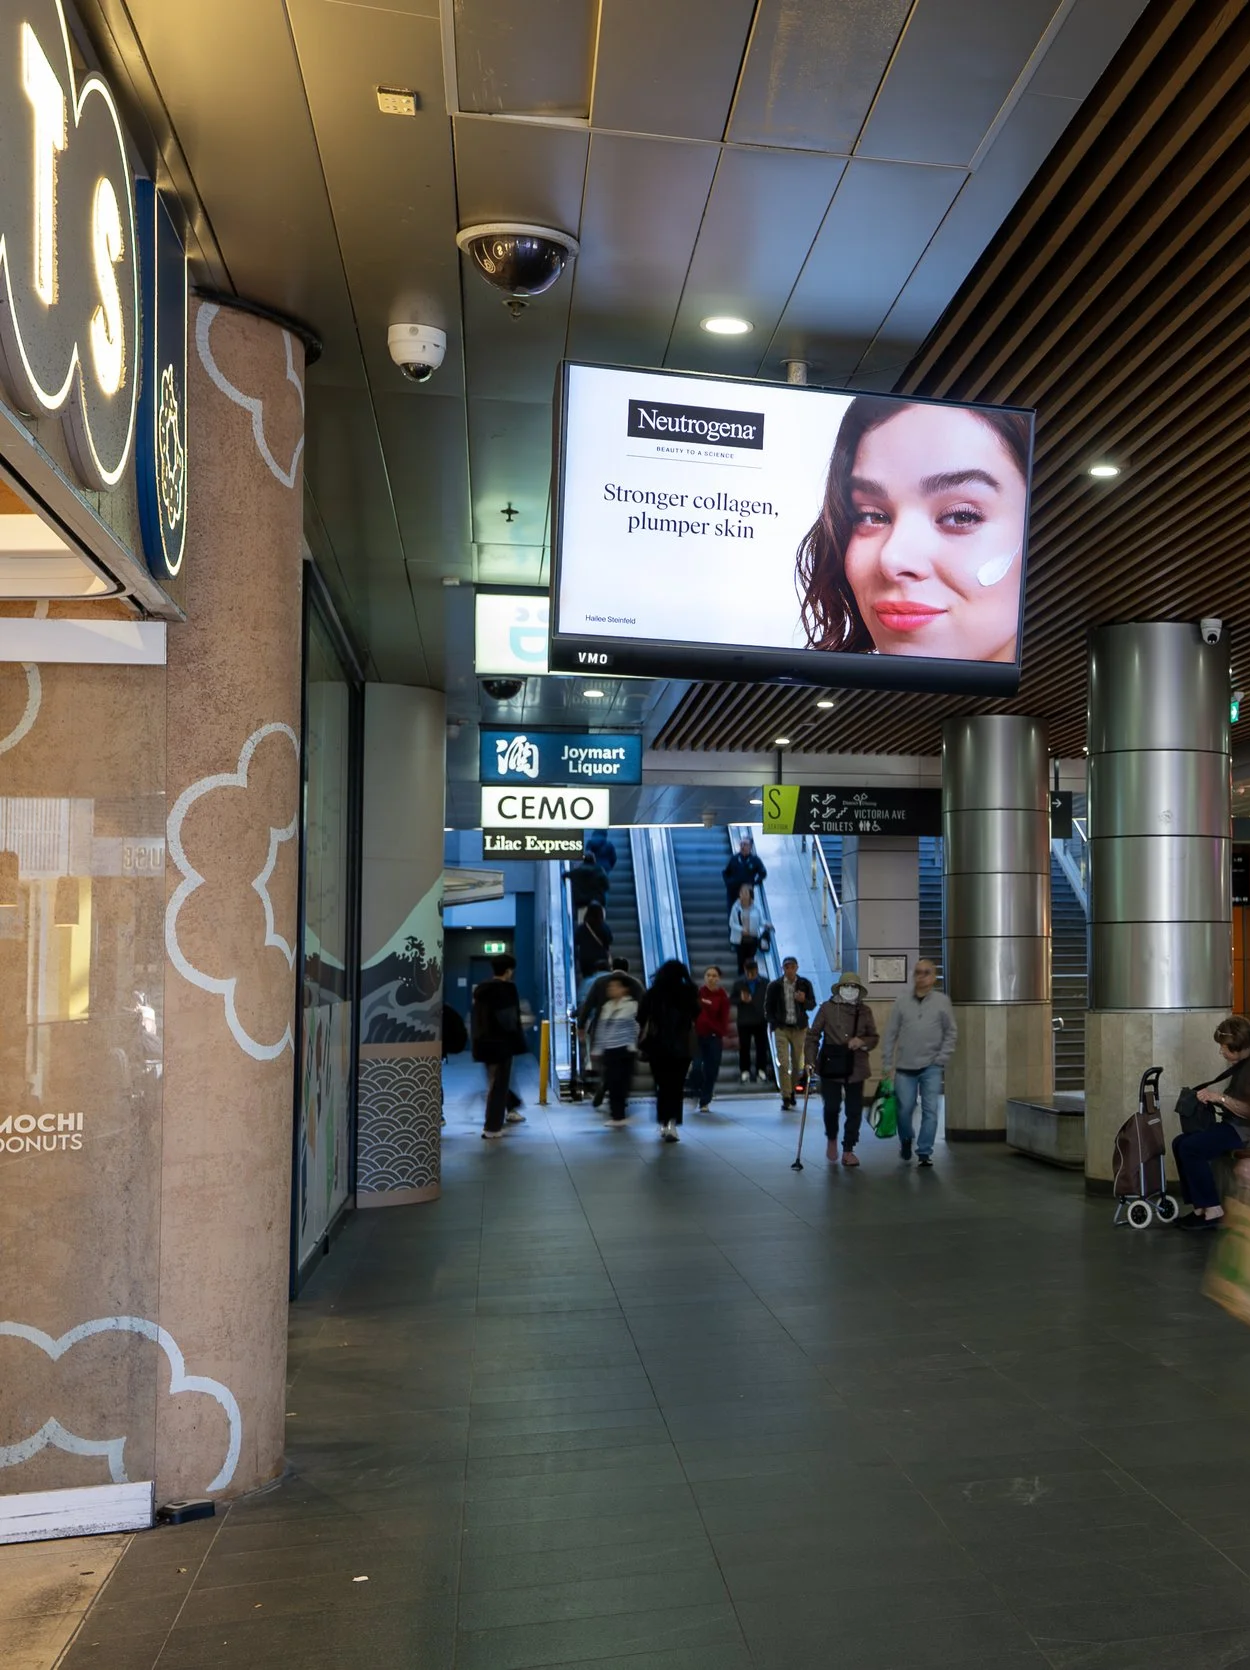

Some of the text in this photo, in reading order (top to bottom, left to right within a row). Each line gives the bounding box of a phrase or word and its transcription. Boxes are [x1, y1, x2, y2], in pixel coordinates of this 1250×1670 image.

[637, 408, 757, 441] Neutrogena
[656, 446, 683, 454] BEAUTY
[704, 451, 734, 459] SCIENCE
[603, 483, 779, 519] Stronger collagen,
[628, 511, 754, 539] plumper skin
[585, 614, 636, 625] Hailee Steinfeld
[578, 652, 608, 665] VMO
[561, 745, 626, 760] Joymart
[569, 761, 620, 776] Liquor
[497, 795, 594, 820] CEMO
[768, 788, 781, 820] S
[853, 809, 906, 820] VICTORIA AVE
[822, 821, 854, 832] TOILETS
[484, 835, 583, 854] Lilac Express
